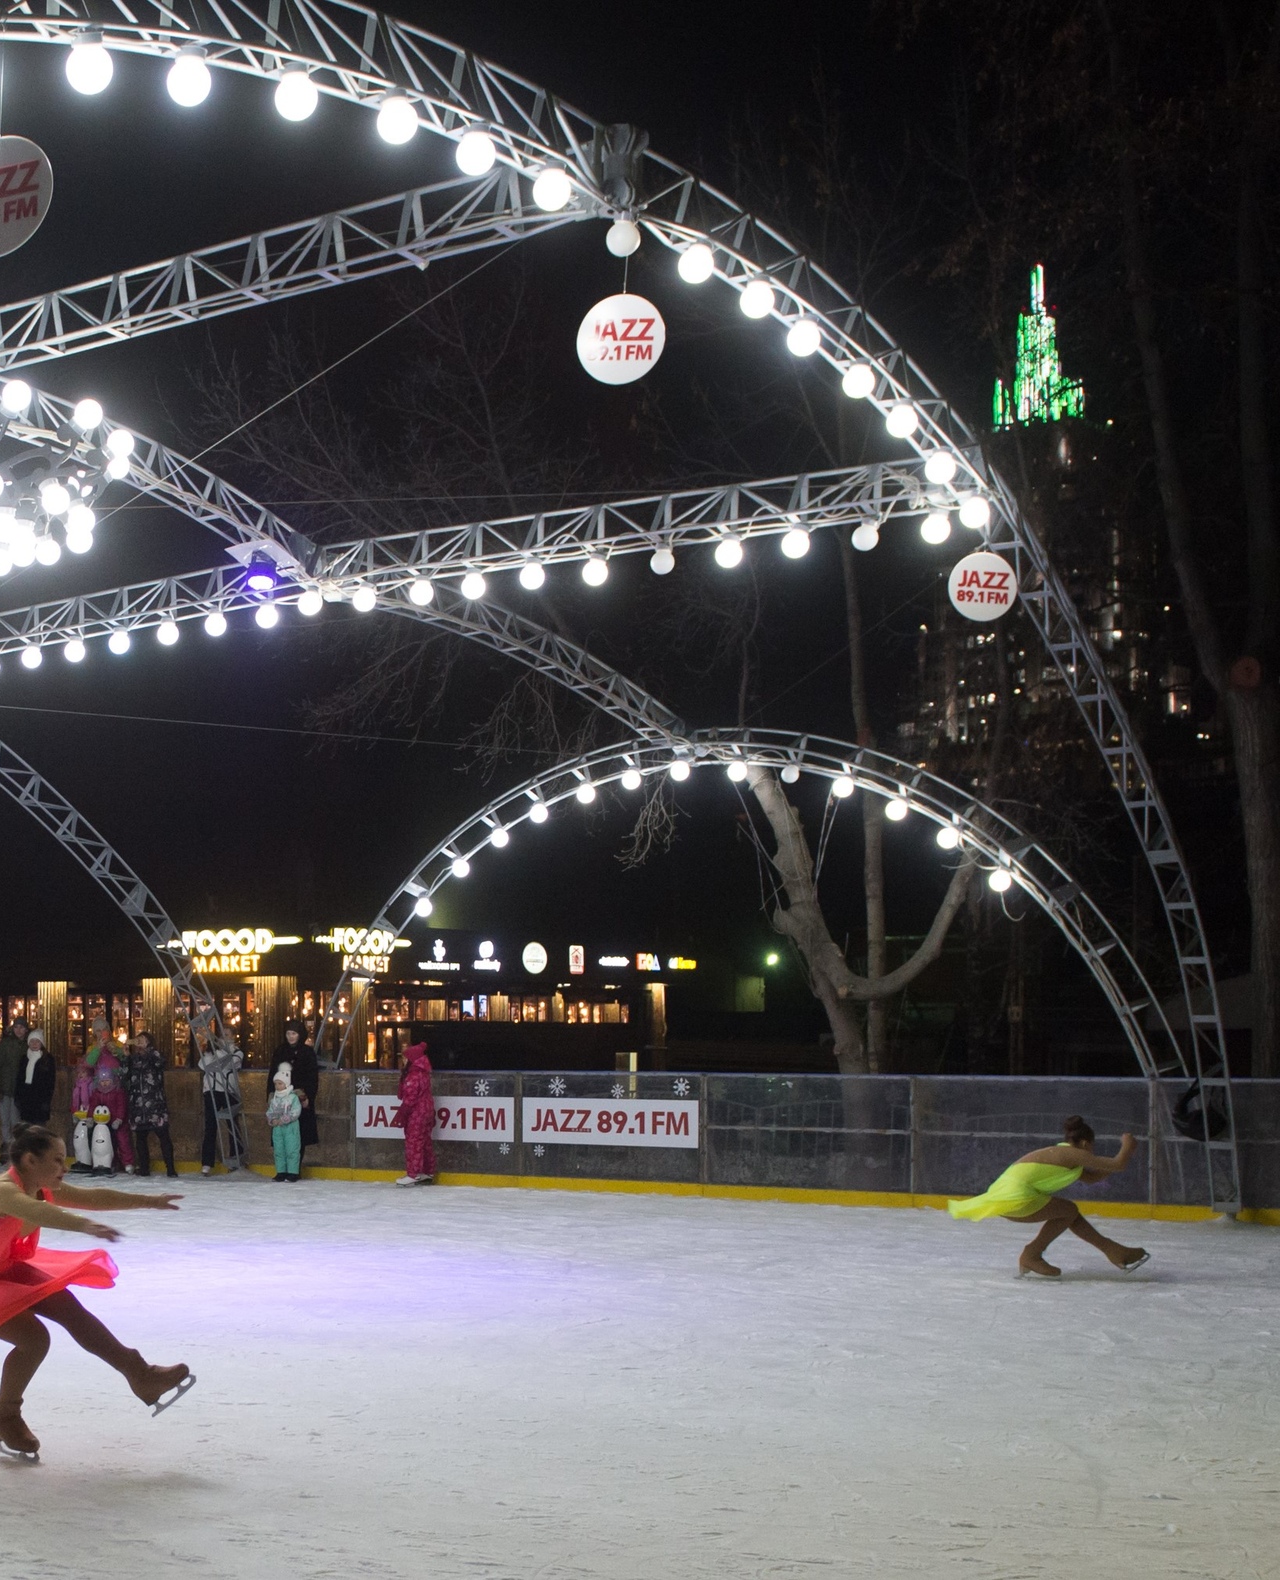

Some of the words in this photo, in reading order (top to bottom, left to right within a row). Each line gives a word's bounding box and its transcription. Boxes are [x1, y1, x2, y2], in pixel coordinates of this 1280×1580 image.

[957, 569, 1010, 590] JAZZ
[192, 955, 261, 973] MARKET
[364, 1105, 406, 1128] JAZ
[433, 1107, 466, 1129] 9.1
[531, 1108, 592, 1133] JAZZ
[597, 1110, 646, 1135] 89.1
[651, 1111, 689, 1136] FM
